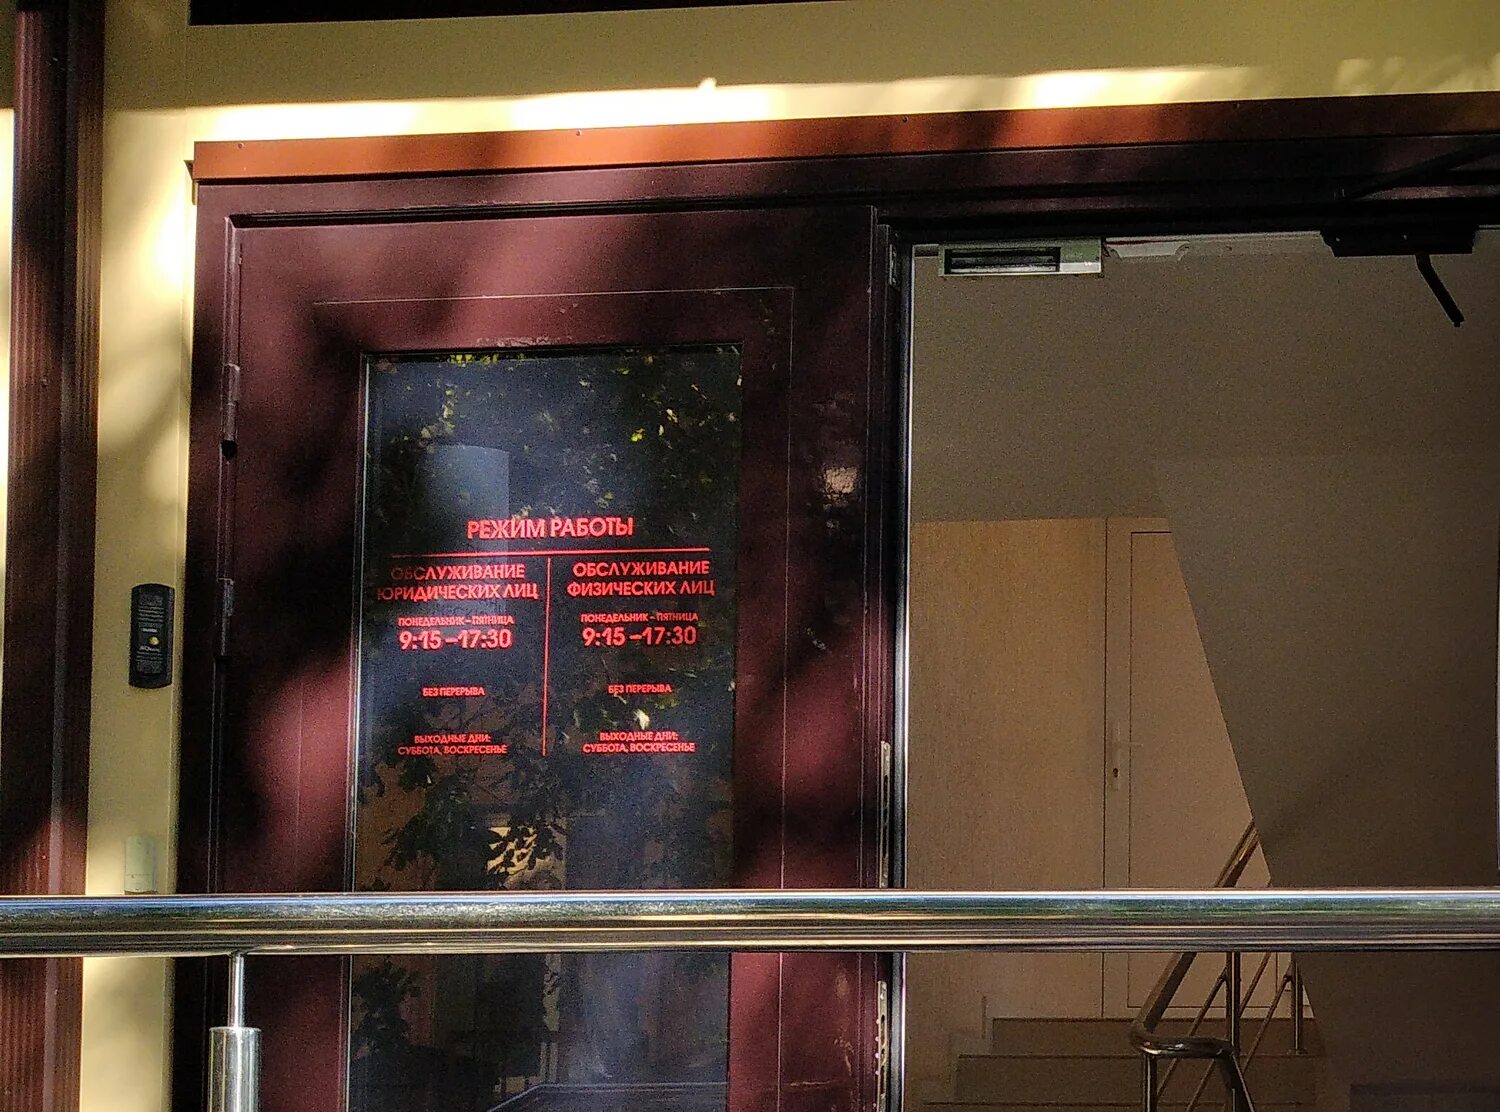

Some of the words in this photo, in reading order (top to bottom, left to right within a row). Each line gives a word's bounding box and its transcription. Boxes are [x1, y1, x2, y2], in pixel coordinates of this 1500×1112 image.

[467, 518, 546, 539] РЕЖИМ
[550, 517, 634, 537] РАБОТЫ
[391, 564, 526, 580] ОБСЛУЖИВАНИЕ
[572, 561, 710, 577] ОБСЛУЖИВАНИЕ
[377, 584, 500, 602] ЮРИДИЧЕСКИХ
[502, 583, 539, 600] ЛИЦ
[567, 581, 676, 597] ФИЗИЧЕСКИХ
[679, 580, 715, 597] ЛИЦ
[422, 687, 438, 697] БЕЗ
[439, 686, 485, 697] ПЕРЕРЫВА
[608, 685, 625, 694] БЕЗ
[625, 684, 672, 694] ПЕРЕРЫВА
[414, 735, 466, 745] ВЫХОДНЫЕ
[600, 732, 653, 742] ВЫХОДНЫЕ
[443, 745, 508, 755] ВОСКРЕСЕНЬЕ
[582, 744, 629, 753] СУББОТА,
[629, 743, 696, 753] ВОСКРЕСЕНЬЕ
